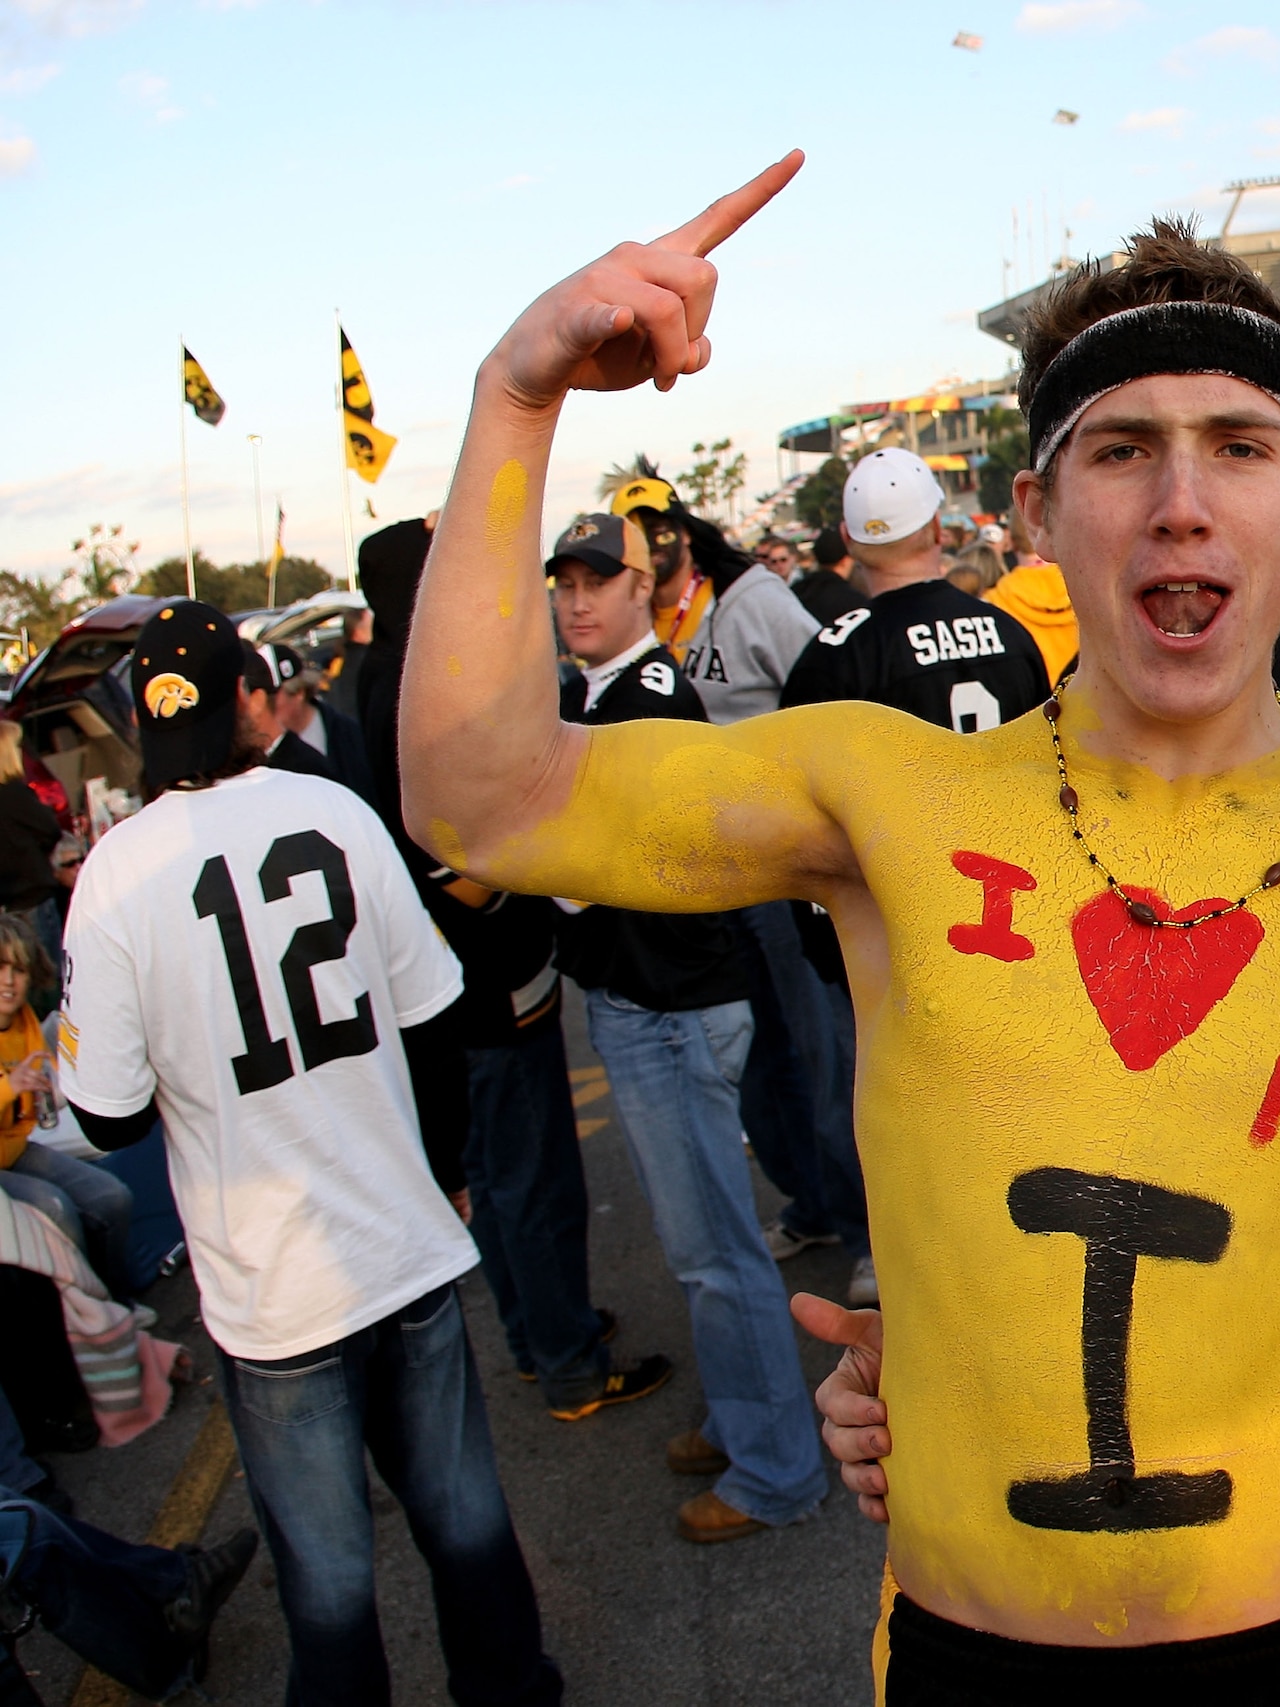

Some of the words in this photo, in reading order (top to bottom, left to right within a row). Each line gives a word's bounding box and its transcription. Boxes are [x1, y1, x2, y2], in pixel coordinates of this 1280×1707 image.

[819, 607, 872, 646] 9
[906, 616, 1005, 666] SASH
[640, 661, 675, 696] 9
[947, 850, 1037, 962] I
[192, 829, 380, 1097] 12
[1004, 1166, 1232, 1535] I
